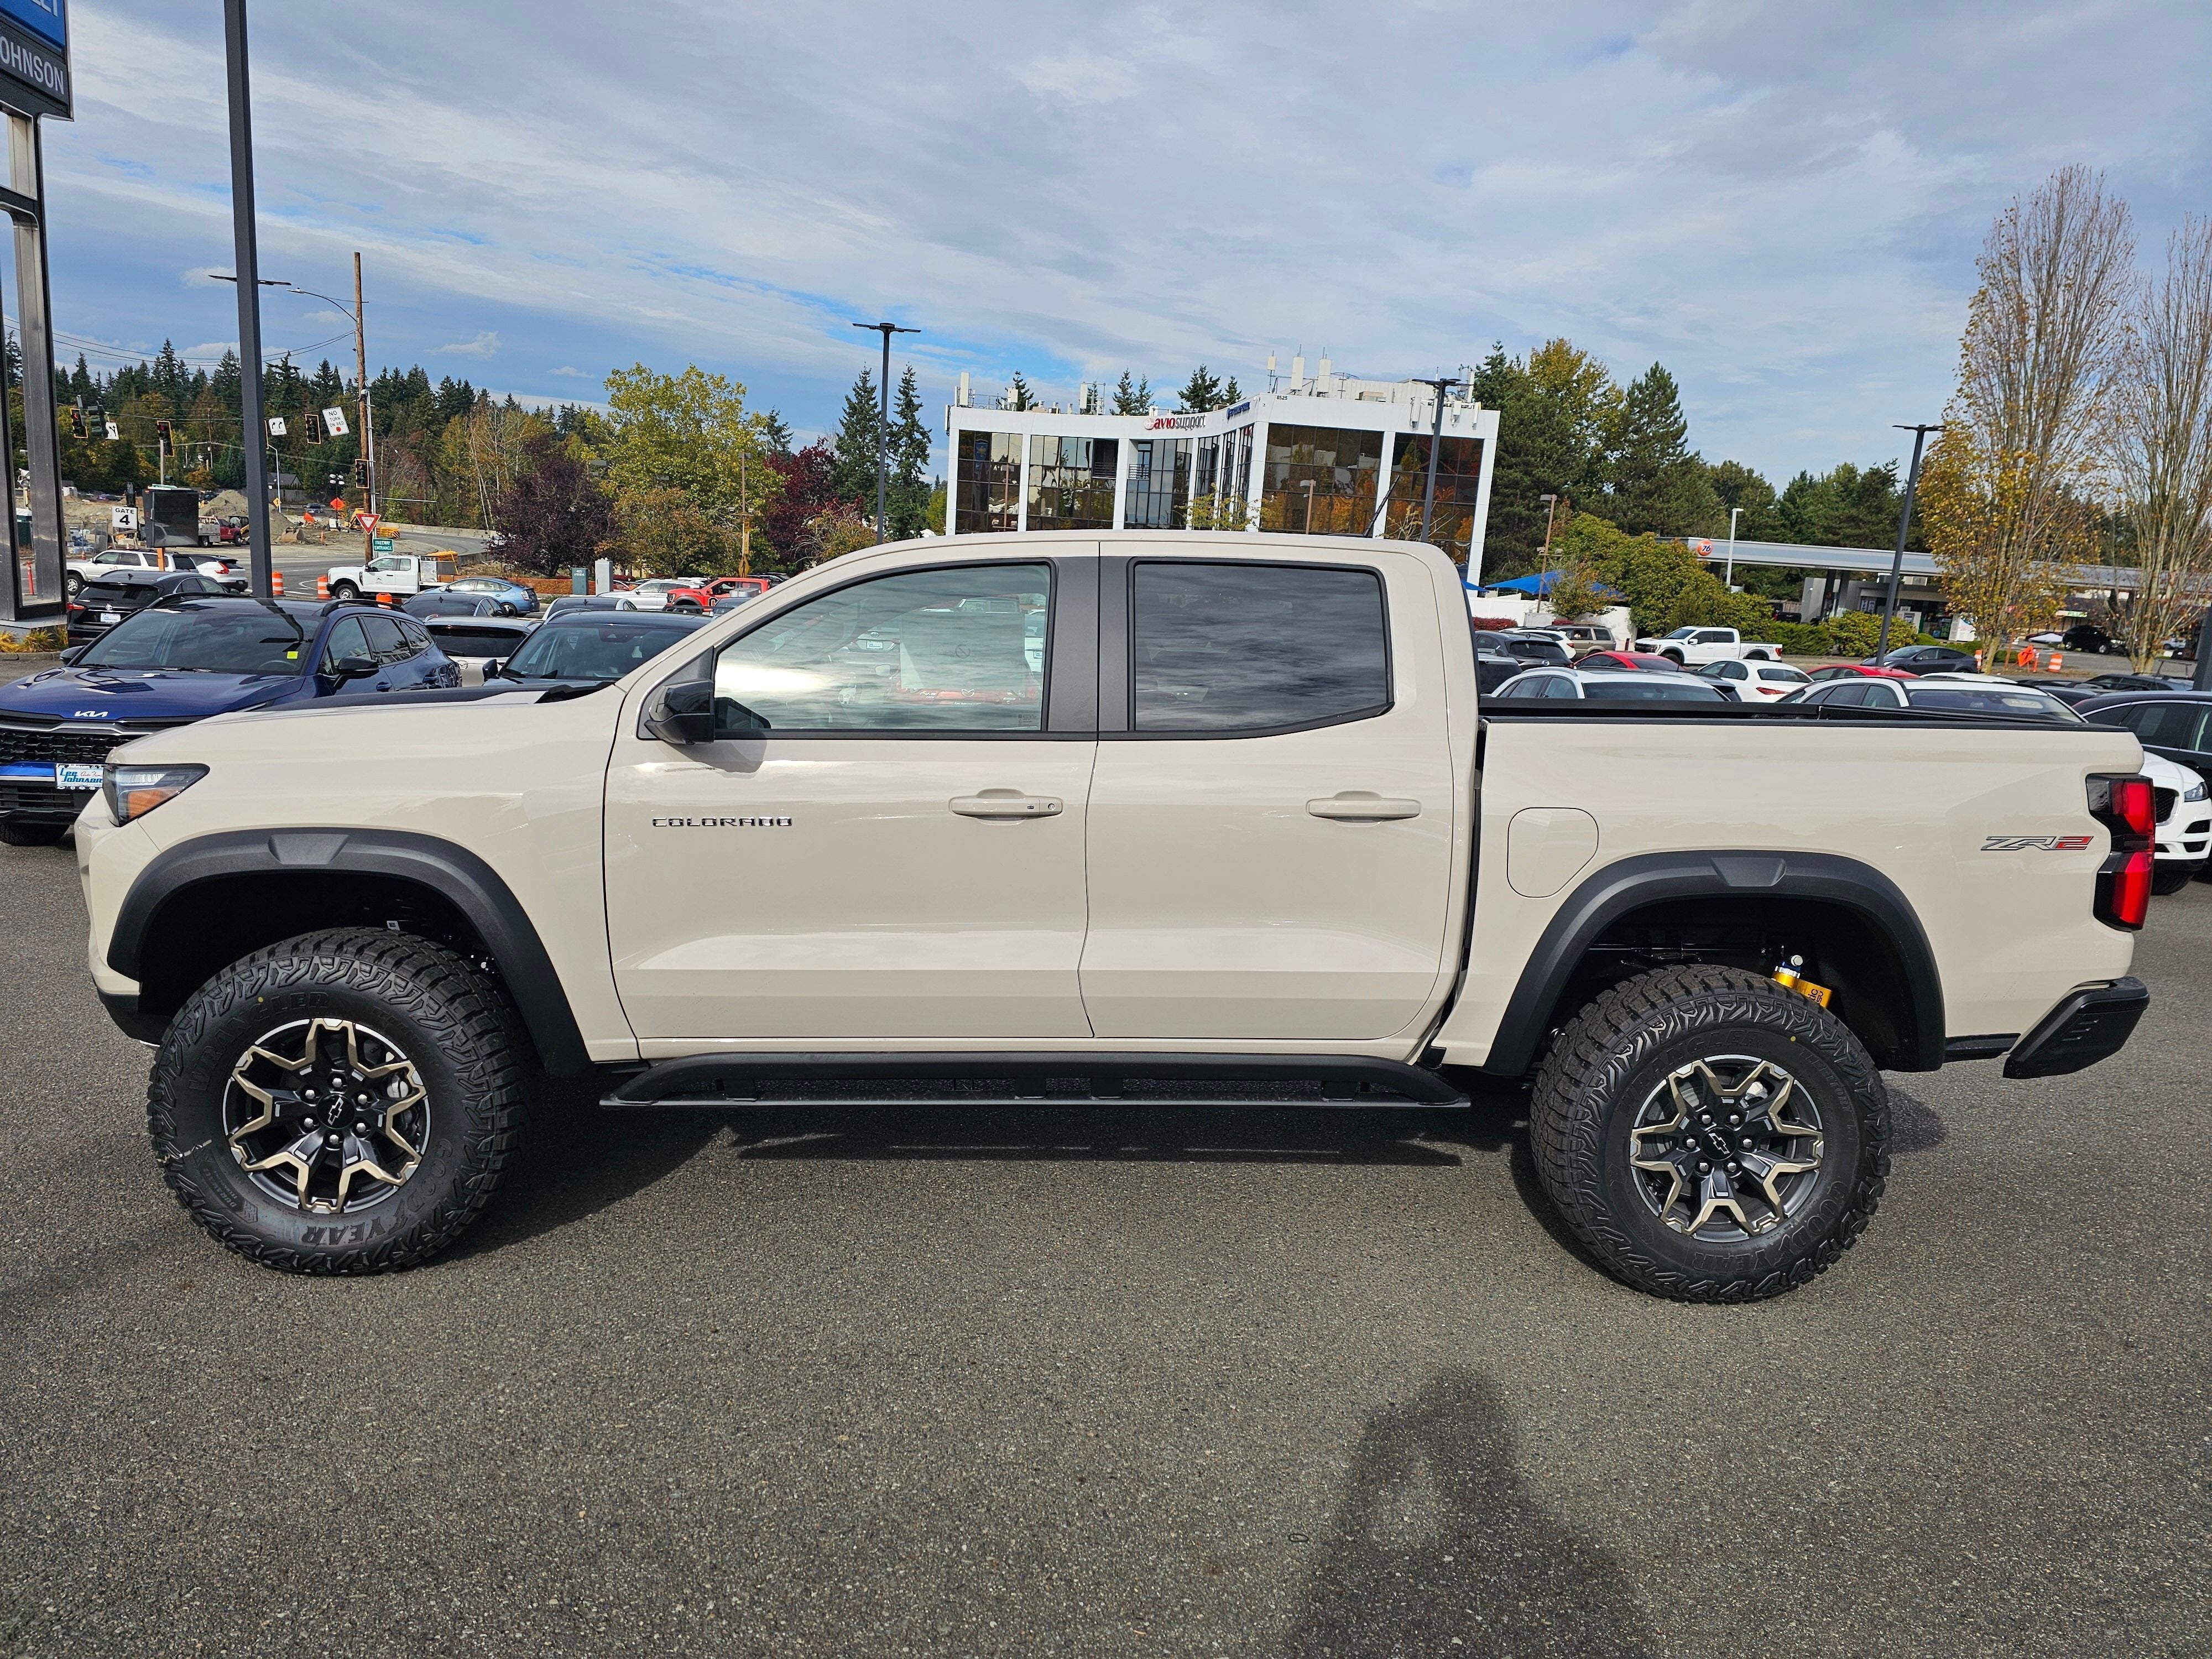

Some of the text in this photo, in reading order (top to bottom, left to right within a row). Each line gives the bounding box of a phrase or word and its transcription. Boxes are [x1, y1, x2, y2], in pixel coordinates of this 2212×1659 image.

[119, 514, 131, 525] 4
[60, 768, 78, 776] Lee
[652, 816, 793, 827] COLORADO
[1980, 836, 2094, 851] ZR2
